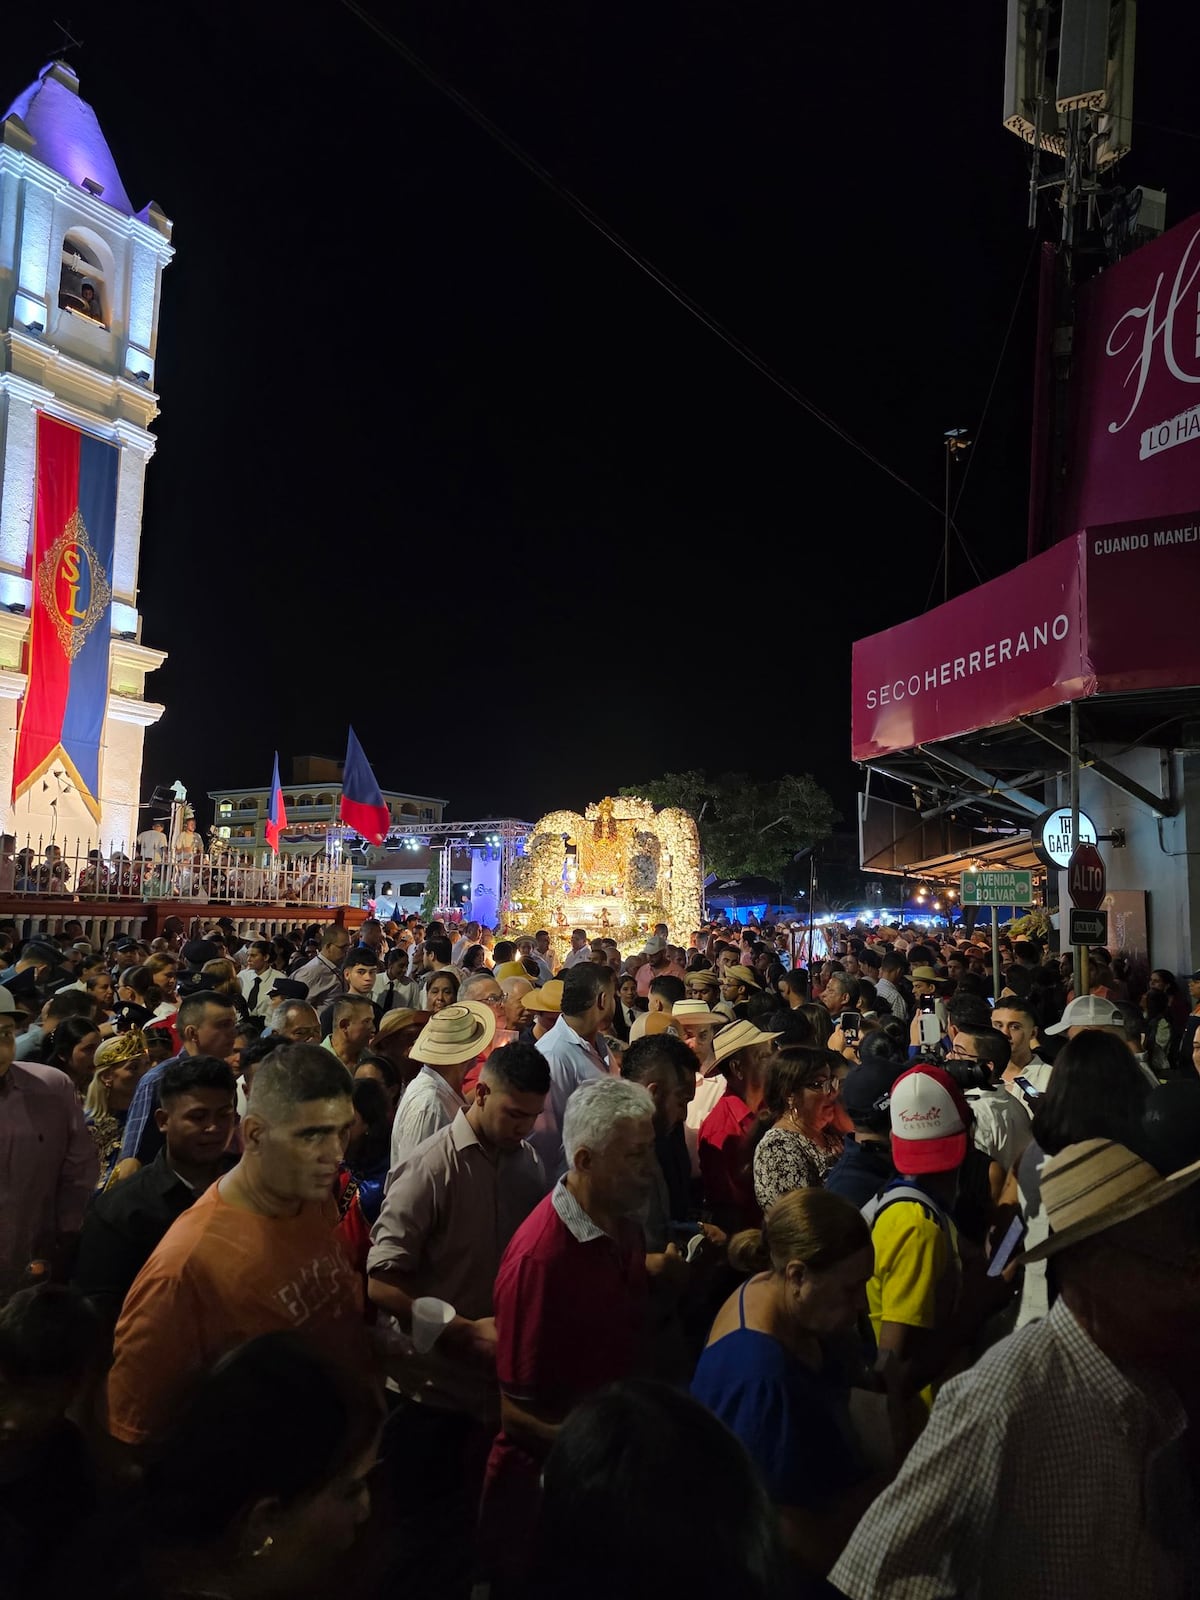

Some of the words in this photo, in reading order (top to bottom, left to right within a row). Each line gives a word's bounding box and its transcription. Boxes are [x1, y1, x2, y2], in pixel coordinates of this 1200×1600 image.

[1149, 425, 1170, 450] LO
[1094, 534, 1149, 556] CUANDO
[1153, 525, 1200, 547] MANEJ
[975, 873, 1016, 887] AVENIDA
[1072, 864, 1103, 892] ALTO
[975, 886, 1016, 901] BOLÍVAR
[903, 1120, 941, 1130] CASINO
